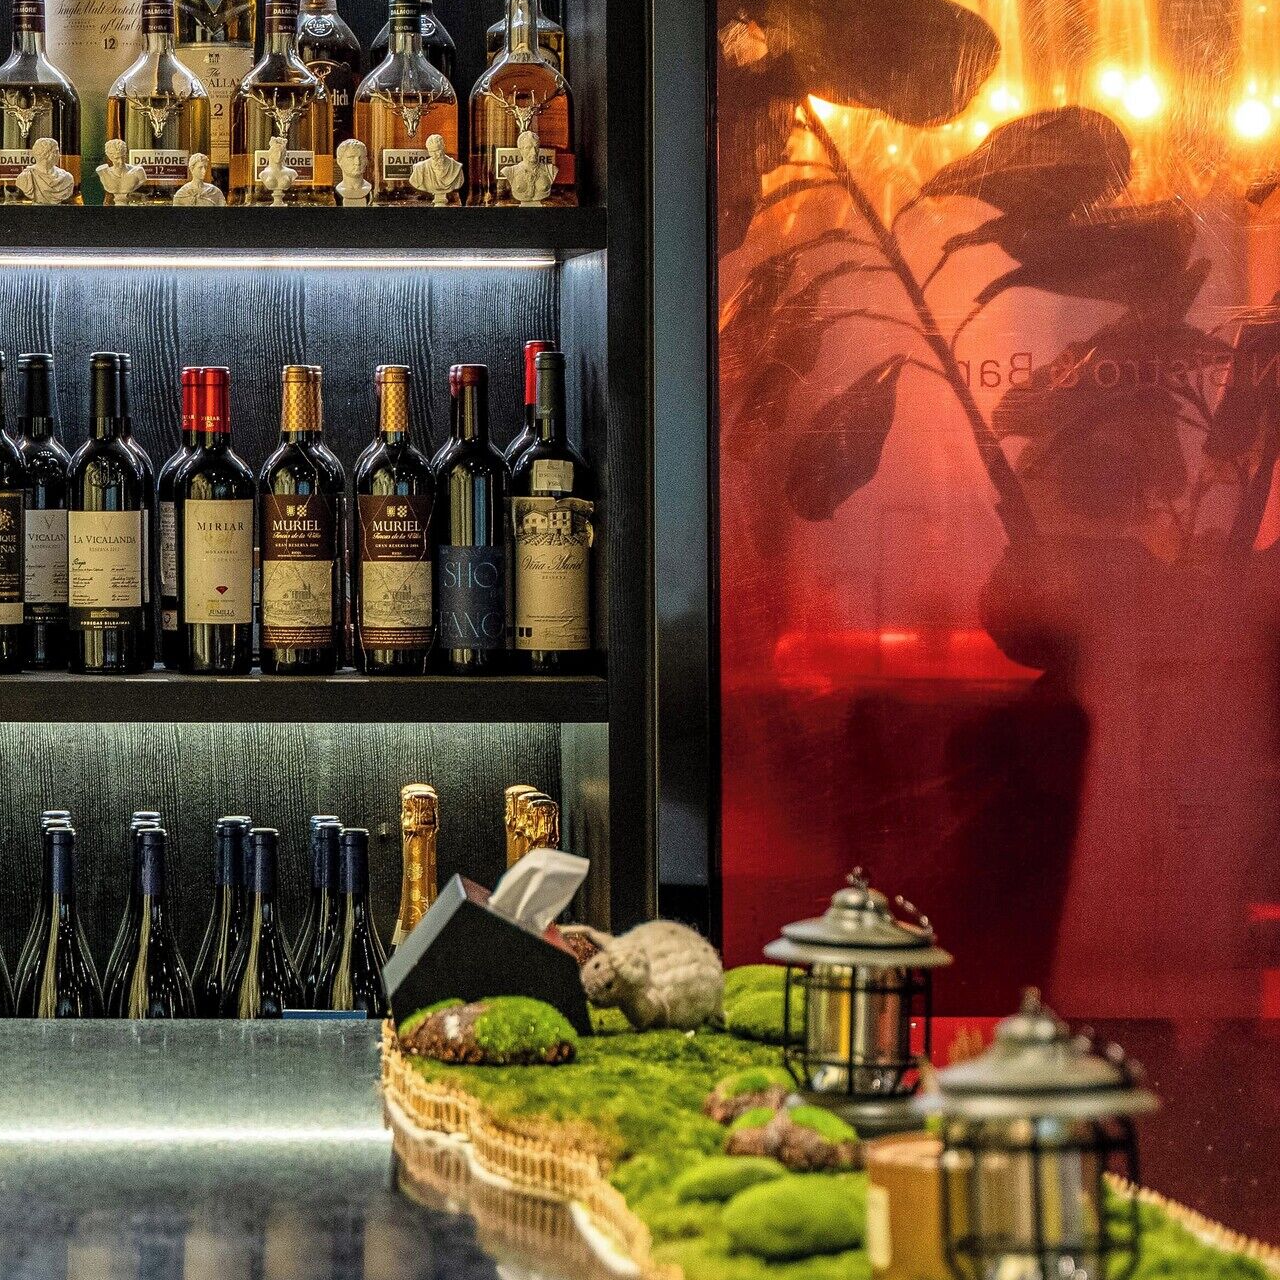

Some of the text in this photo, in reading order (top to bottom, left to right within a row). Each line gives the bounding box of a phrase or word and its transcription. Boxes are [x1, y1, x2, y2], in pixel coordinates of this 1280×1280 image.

[134, 157, 187, 165] DALMORE
[155, 166, 165, 174] 12
[197, 522, 244, 531] MIRIAR
[273, 520, 321, 530] MURIEL
[373, 521, 421, 531] MURIEL
[74, 535, 136, 544] LA VICALANDA
